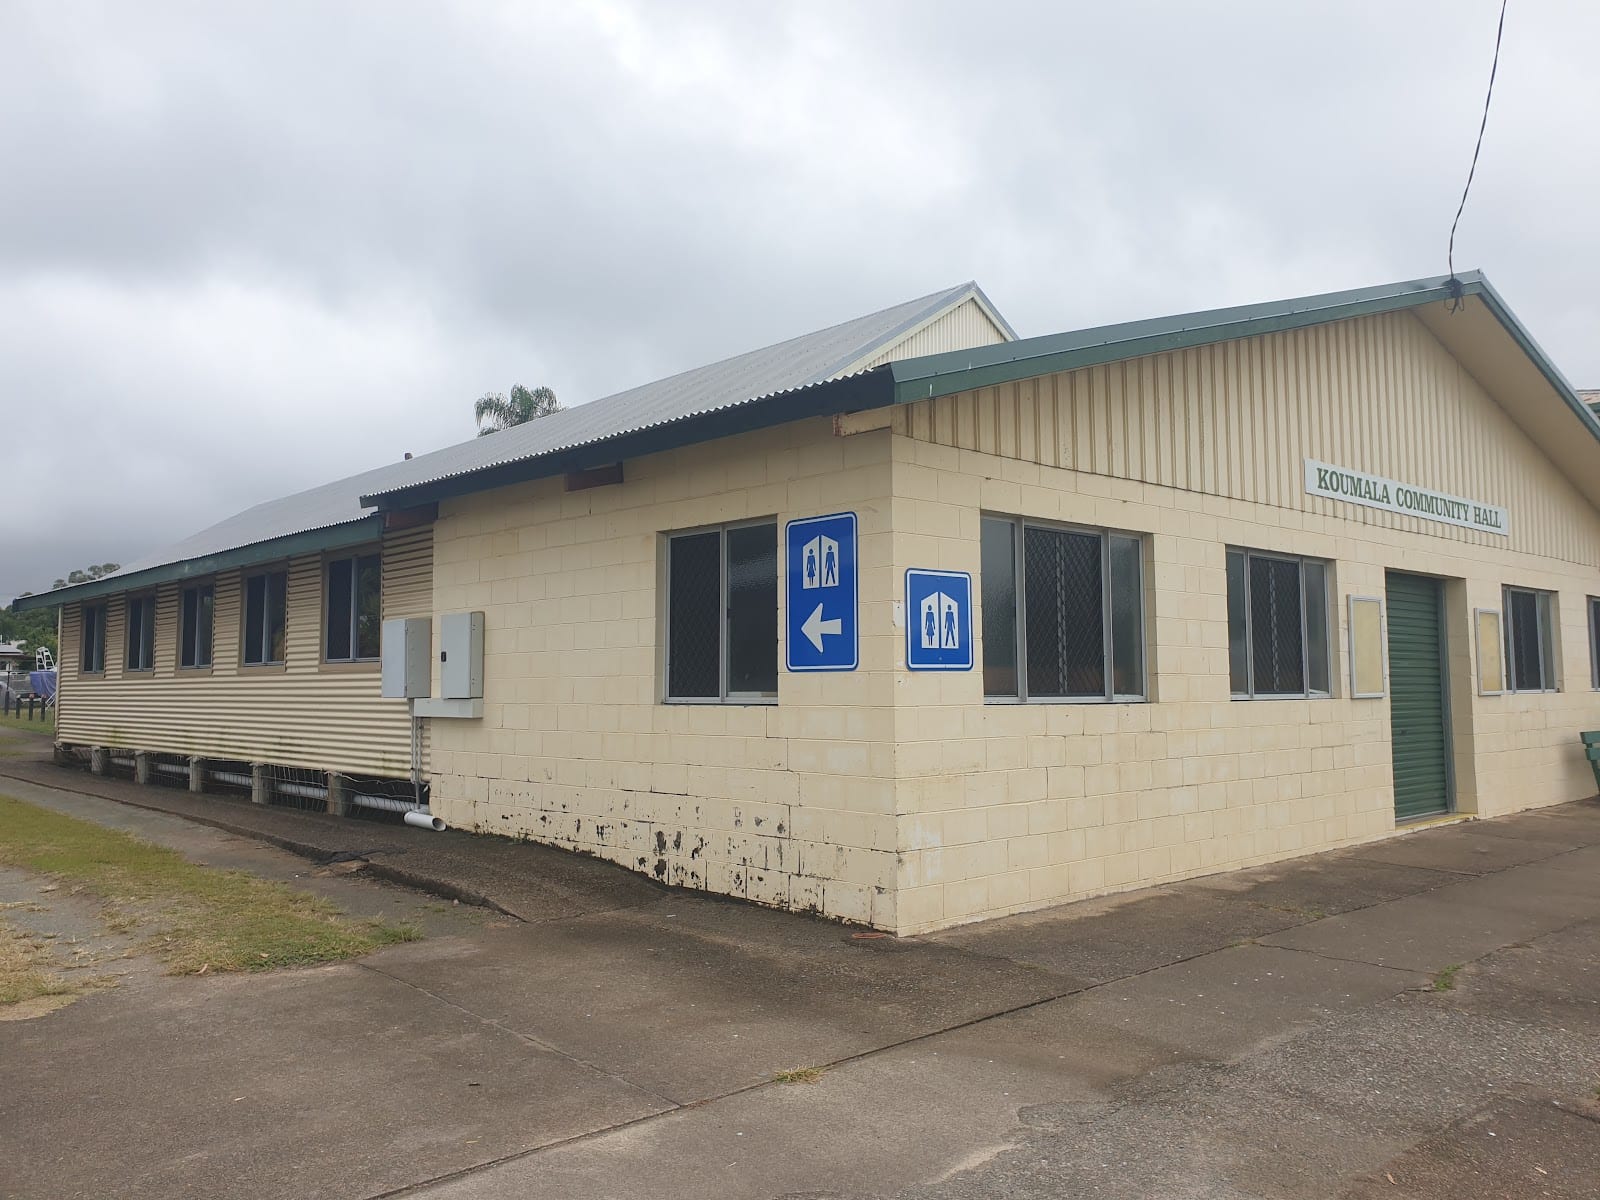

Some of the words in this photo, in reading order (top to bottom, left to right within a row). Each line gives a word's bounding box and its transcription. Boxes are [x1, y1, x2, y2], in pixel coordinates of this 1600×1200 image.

[1317, 467, 1391, 504] KOUMALA
[1396, 487, 1469, 522] COMMUNITY
[1473, 506, 1501, 528] HALL
